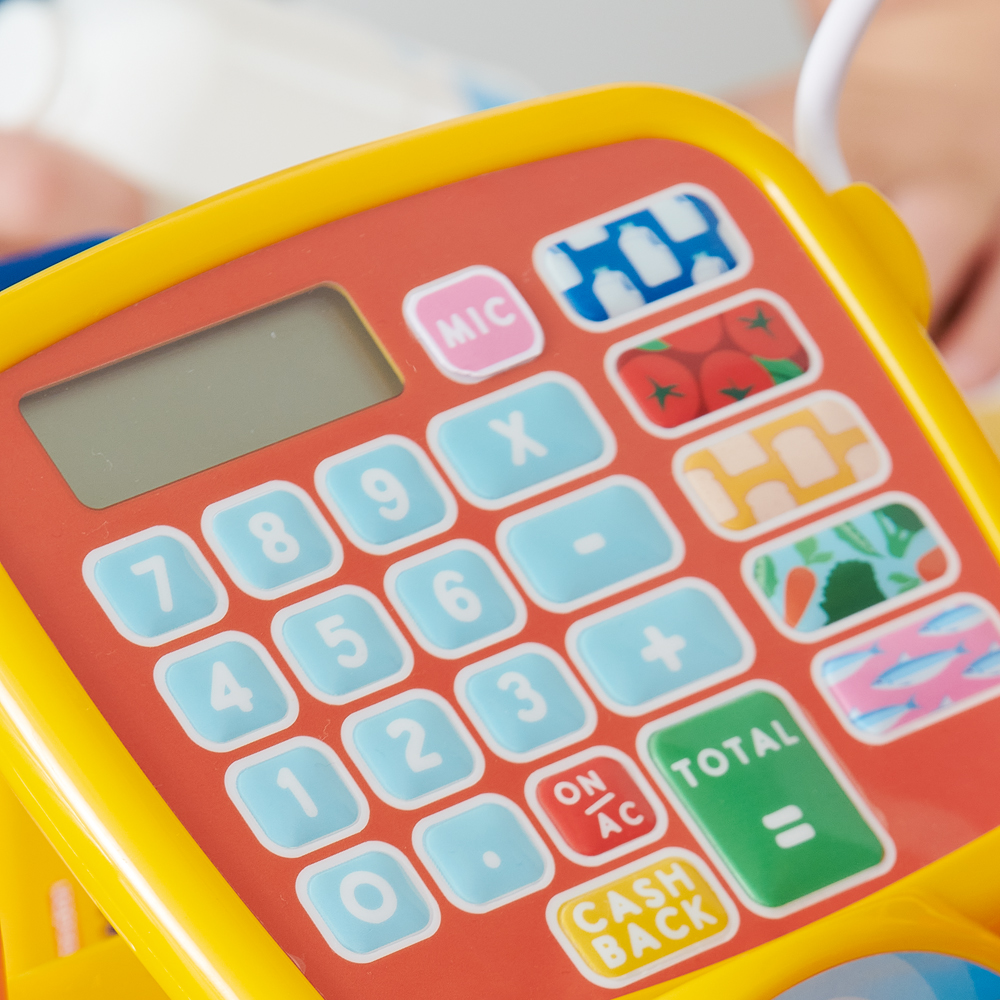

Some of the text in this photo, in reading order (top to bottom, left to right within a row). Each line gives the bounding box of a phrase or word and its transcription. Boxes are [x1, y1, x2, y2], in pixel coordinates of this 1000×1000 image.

[435, 295, 518, 350] MIC
[490, 411, 546, 465] X
[362, 469, 409, 521] 9
[249, 512, 300, 564] 8
[131, 556, 173, 612] 7
[433, 570, 482, 622] 6
[315, 614, 368, 668] 5
[210, 661, 256, 714] 4
[497, 672, 547, 722] 3
[386, 718, 442, 773] 2
[671, 718, 800, 789] TOTAL
[276, 767, 318, 818] 1
[553, 770, 607, 807] ON
[597, 801, 645, 840] AC
[339, 870, 398, 924] 0
[573, 865, 698, 930] CASH
[592, 893, 719, 971] BACK
